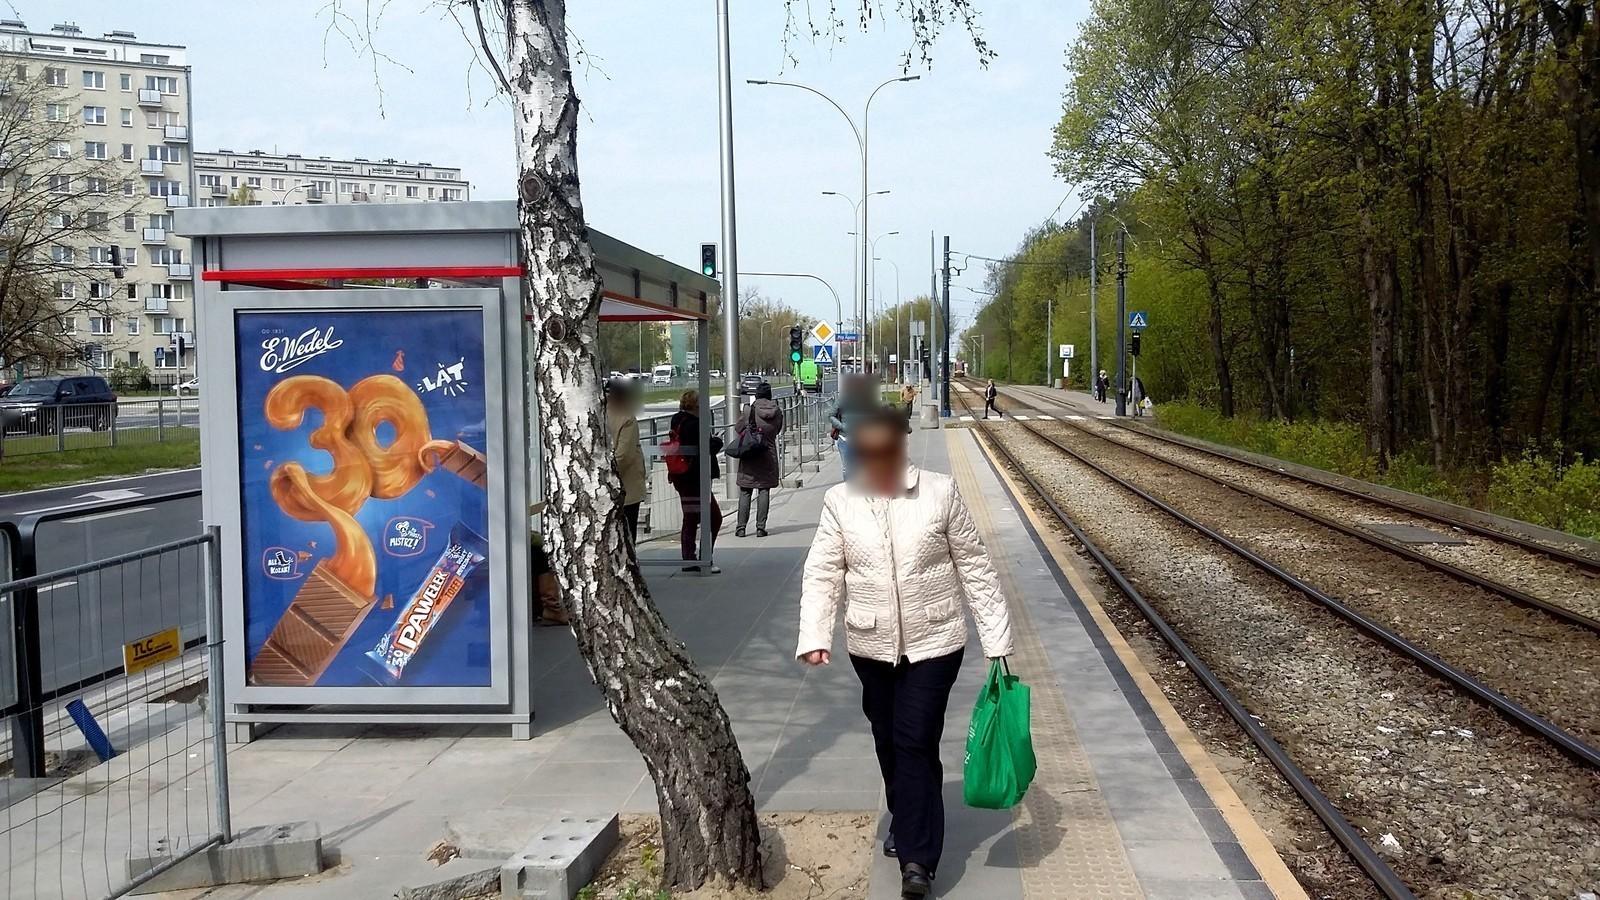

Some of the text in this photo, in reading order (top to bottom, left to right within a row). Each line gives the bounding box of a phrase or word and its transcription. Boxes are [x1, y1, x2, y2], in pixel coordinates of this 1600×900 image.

[422, 362, 464, 391] LAT
[389, 537, 419, 550] MISTRZ!
[132, 638, 153, 656] TLC
